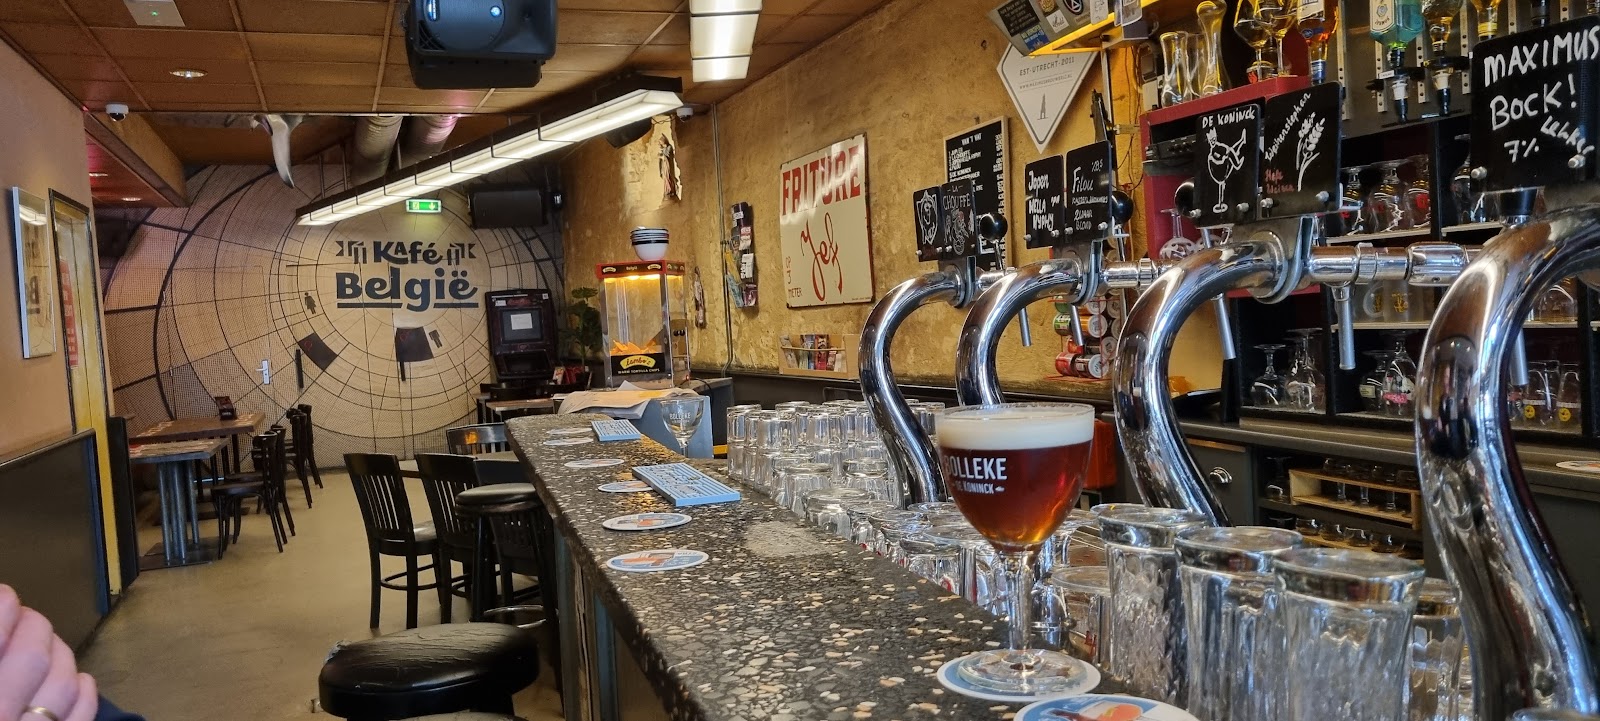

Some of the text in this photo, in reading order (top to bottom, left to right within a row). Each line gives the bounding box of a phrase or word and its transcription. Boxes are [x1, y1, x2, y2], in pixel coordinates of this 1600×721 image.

[1484, 25, 1600, 87] MAXIMUS
[1489, 73, 1577, 131] BOCK!
[1202, 115, 1213, 129] DE
[1503, 138, 1540, 163] 7%
[782, 145, 861, 216] FRITURE
[942, 193, 971, 210] CHOUFFE
[336, 266, 478, 312] België
[944, 455, 1008, 480] BOLLEKE
[962, 481, 995, 494] KONINCK
